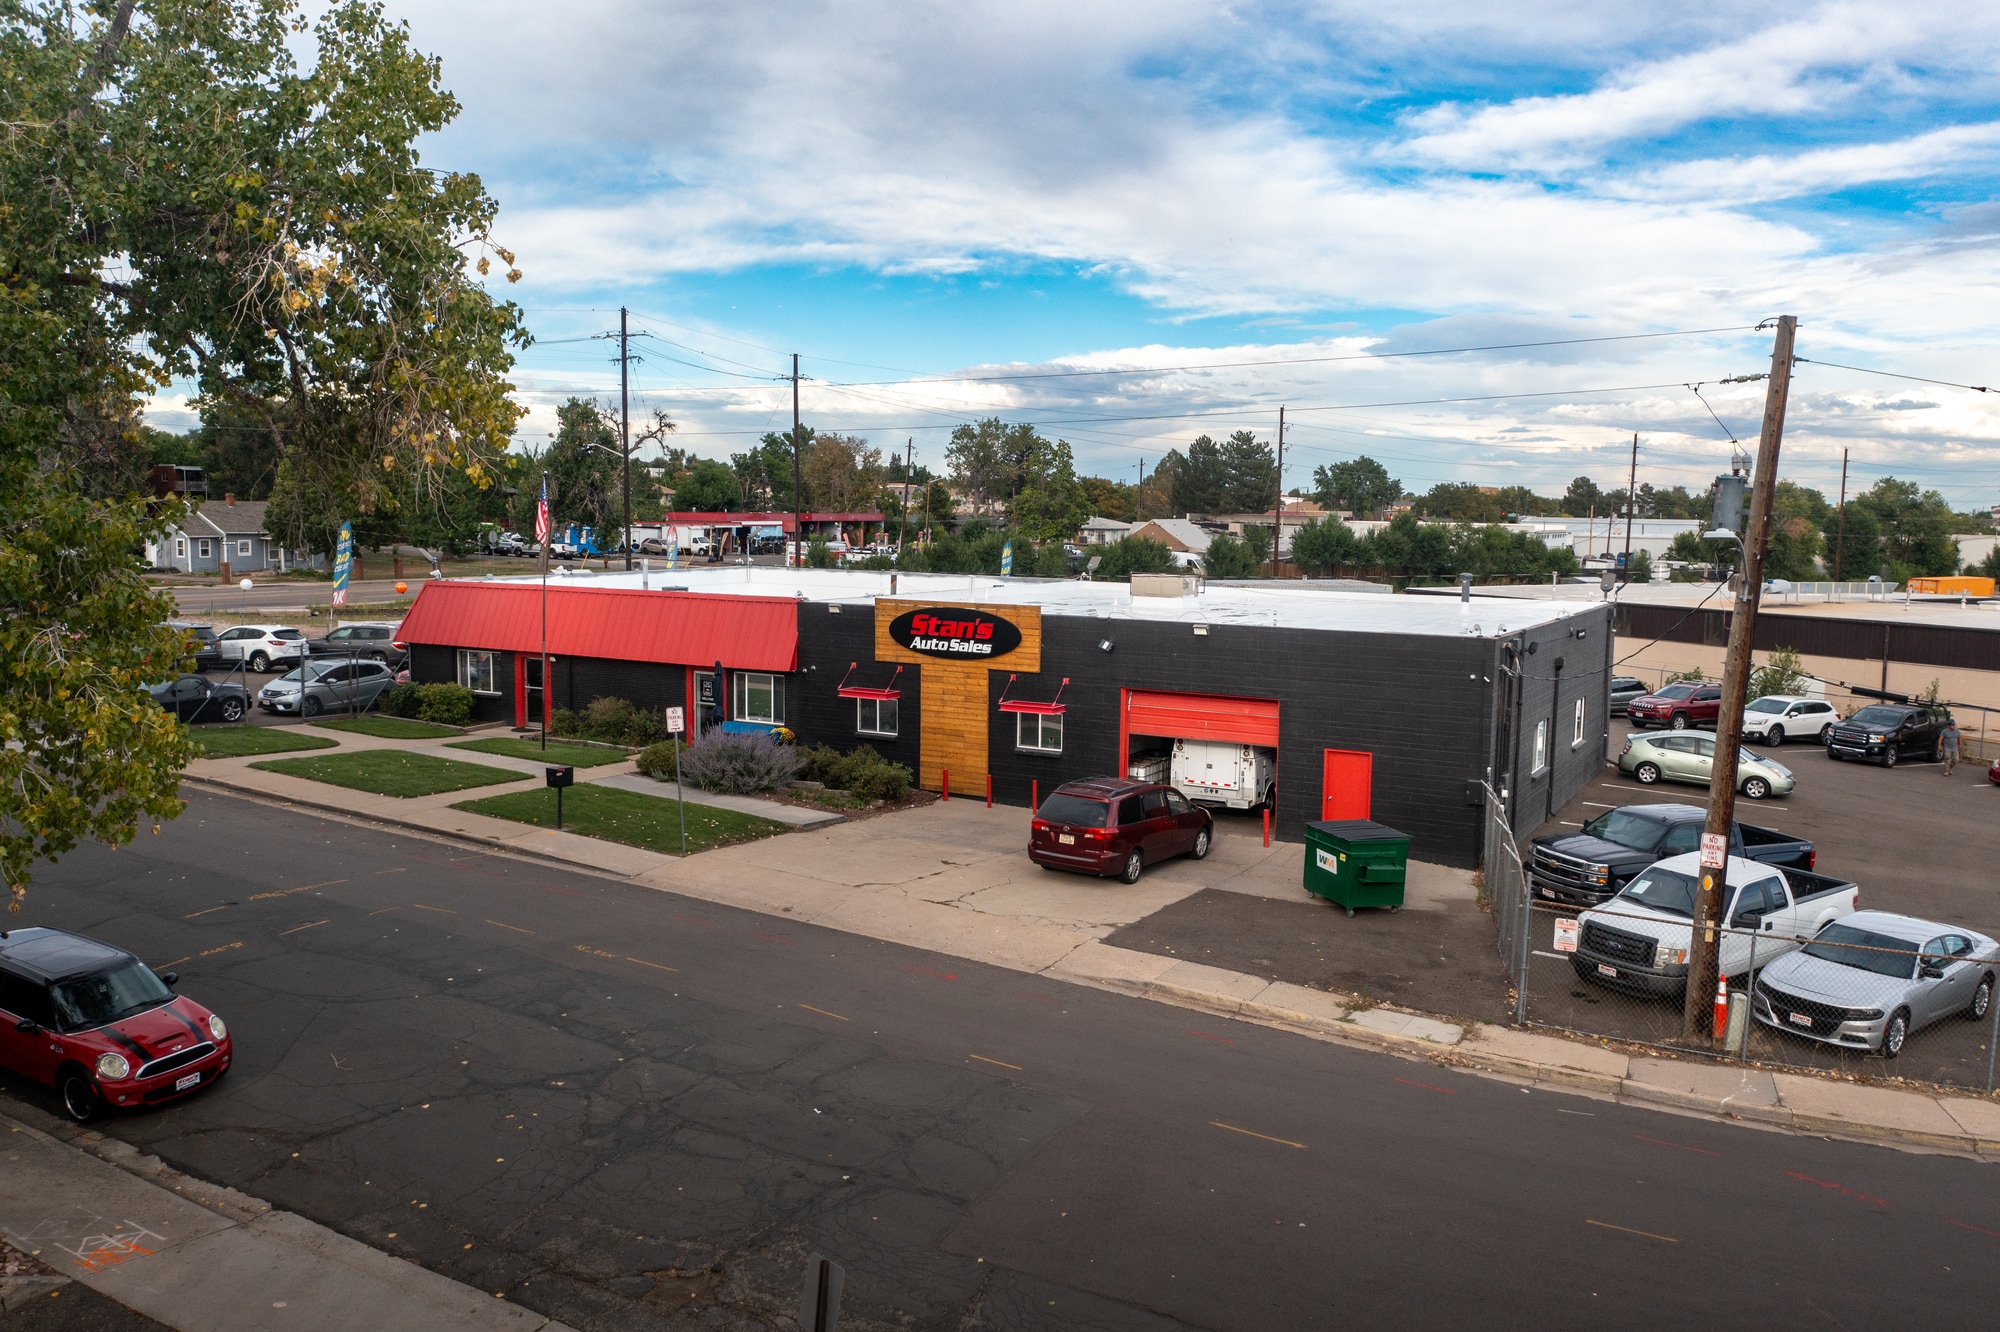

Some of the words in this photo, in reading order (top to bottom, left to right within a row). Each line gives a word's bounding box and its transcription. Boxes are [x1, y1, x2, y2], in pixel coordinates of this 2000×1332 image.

[336, 552, 350, 565] BAD
[910, 614, 994, 640] Stan's
[909, 637, 948, 651] Auto
[949, 639, 992, 654] Sales
[1709, 836, 1718, 844] NO
[1702, 843, 1724, 851] PARKING
[1319, 854, 1335, 868] WM
